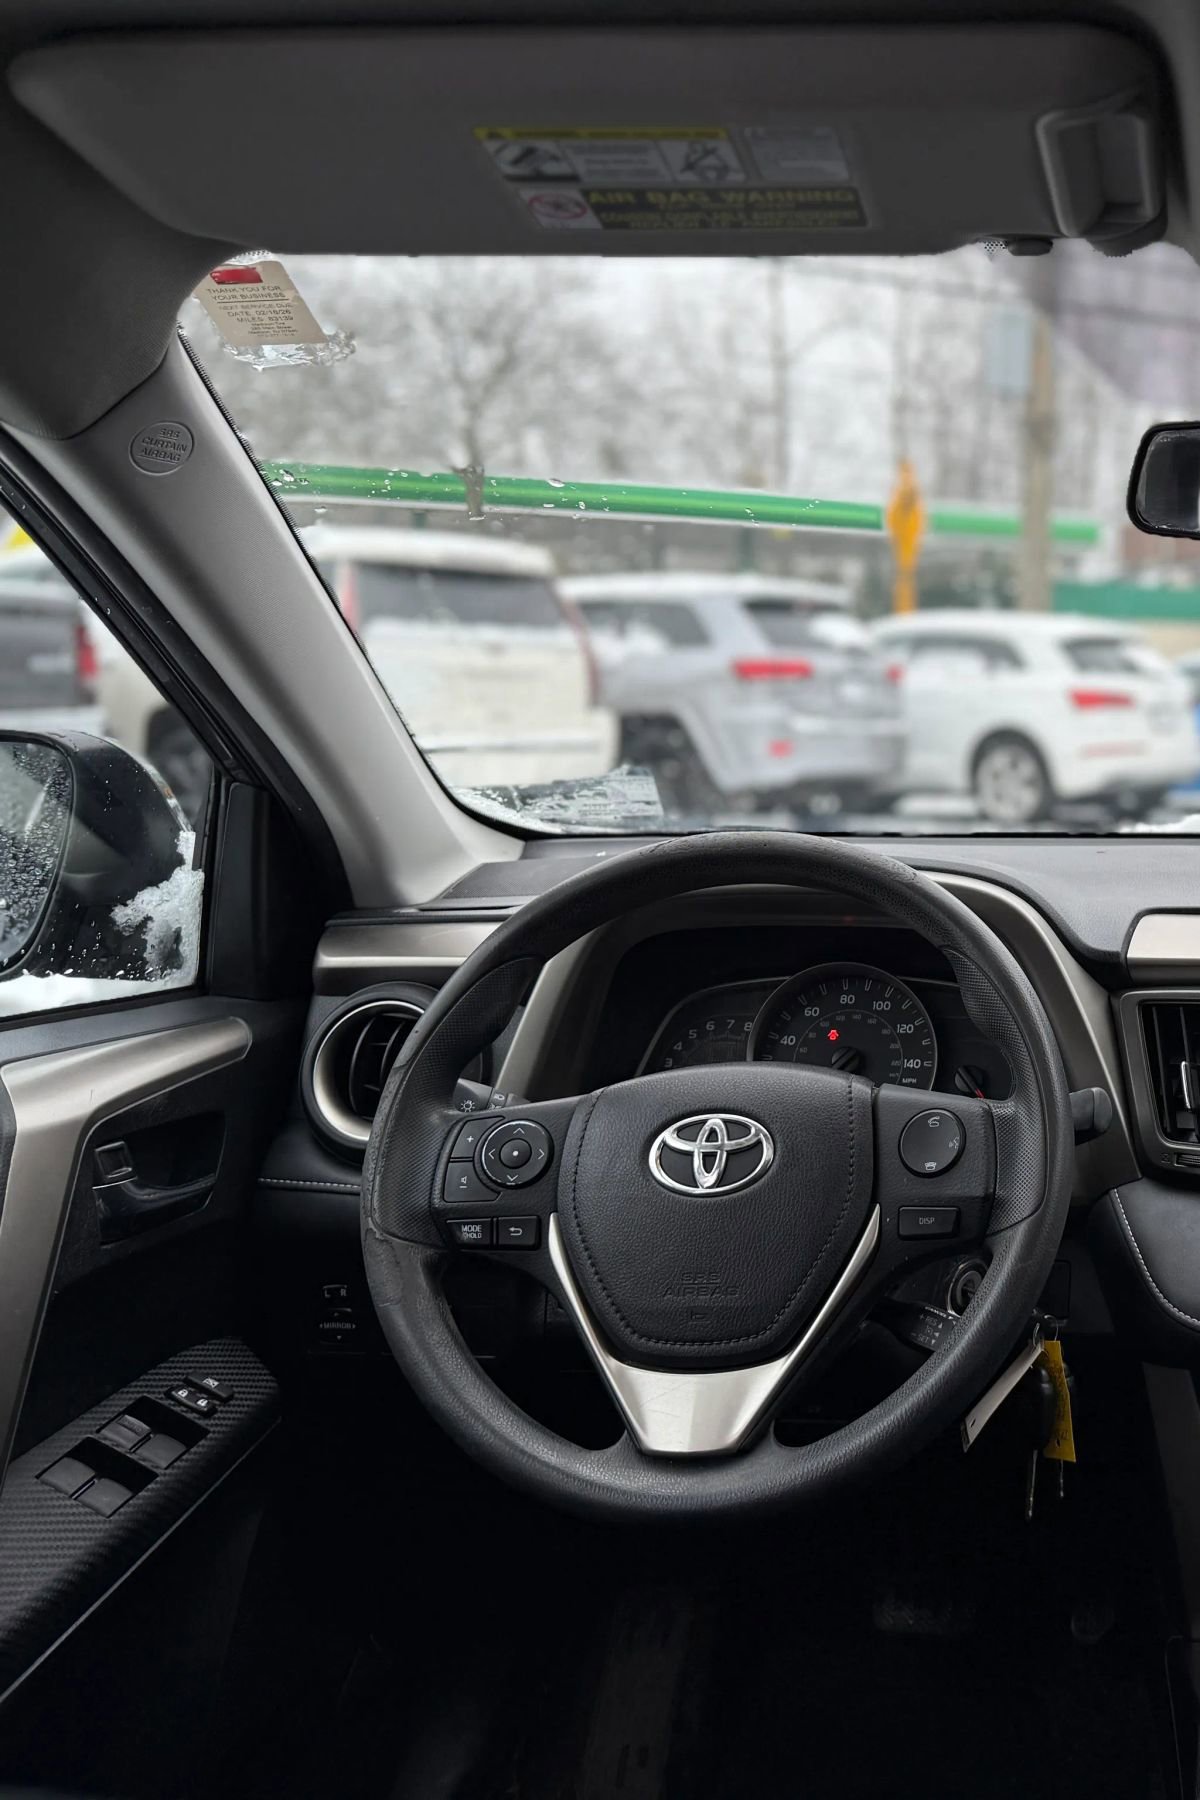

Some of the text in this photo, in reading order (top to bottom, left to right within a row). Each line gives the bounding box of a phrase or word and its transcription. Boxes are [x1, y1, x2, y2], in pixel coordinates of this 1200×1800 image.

[589, 190, 855, 203] AIR BAG WARNING
[240, 292, 286, 300] BUSINESS
[142, 437, 188, 452] CURTAIN
[142, 447, 181, 461] AIRBAG
[840, 994, 856, 1005] 80
[873, 1000, 891, 1011] 100
[804, 1006, 820, 1017] 60
[705, 1020, 716, 1031] 6
[726, 1019, 736, 1030] 7
[744, 1021, 753, 1032] 8
[897, 1023, 914, 1034] 120
[689, 1029, 698, 1039] 5
[673, 1041, 683, 1051] 4
[780, 1035, 796, 1046] 40
[664, 1058, 673, 1068] 3
[904, 1058, 922, 1069] 140
[918, 1217, 935, 1225] DISP
[461, 1224, 482, 1233] MODE
[325, 1288, 347, 1298] L R
[663, 1286, 740, 1298] AIRBAG
